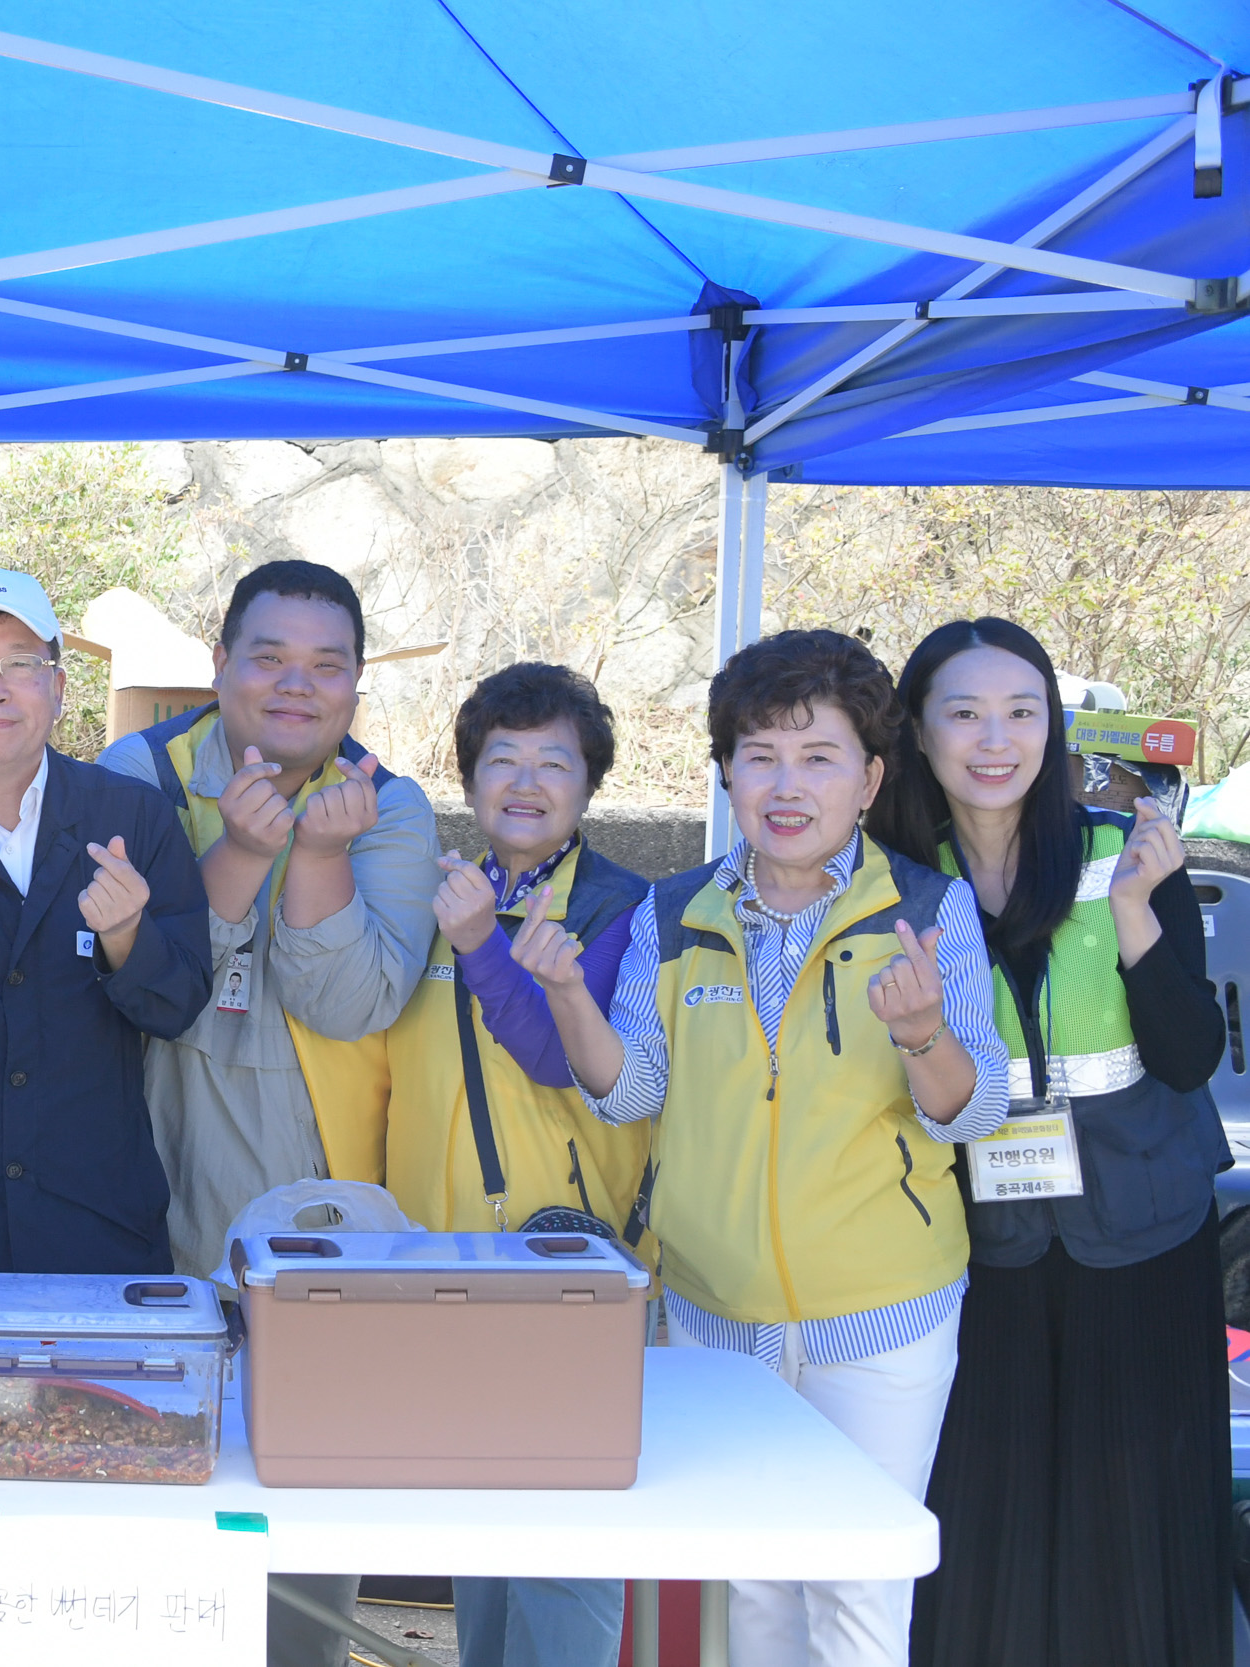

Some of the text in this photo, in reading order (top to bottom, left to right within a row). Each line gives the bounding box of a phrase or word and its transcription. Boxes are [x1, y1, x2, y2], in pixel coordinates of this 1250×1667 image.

[1076, 728, 1097, 742] 대한
[987, 1147, 1056, 1168] 진행요원
[995, 1180, 1055, 1196] 중곡제4동
[159, 1586, 226, 1642] 판매
